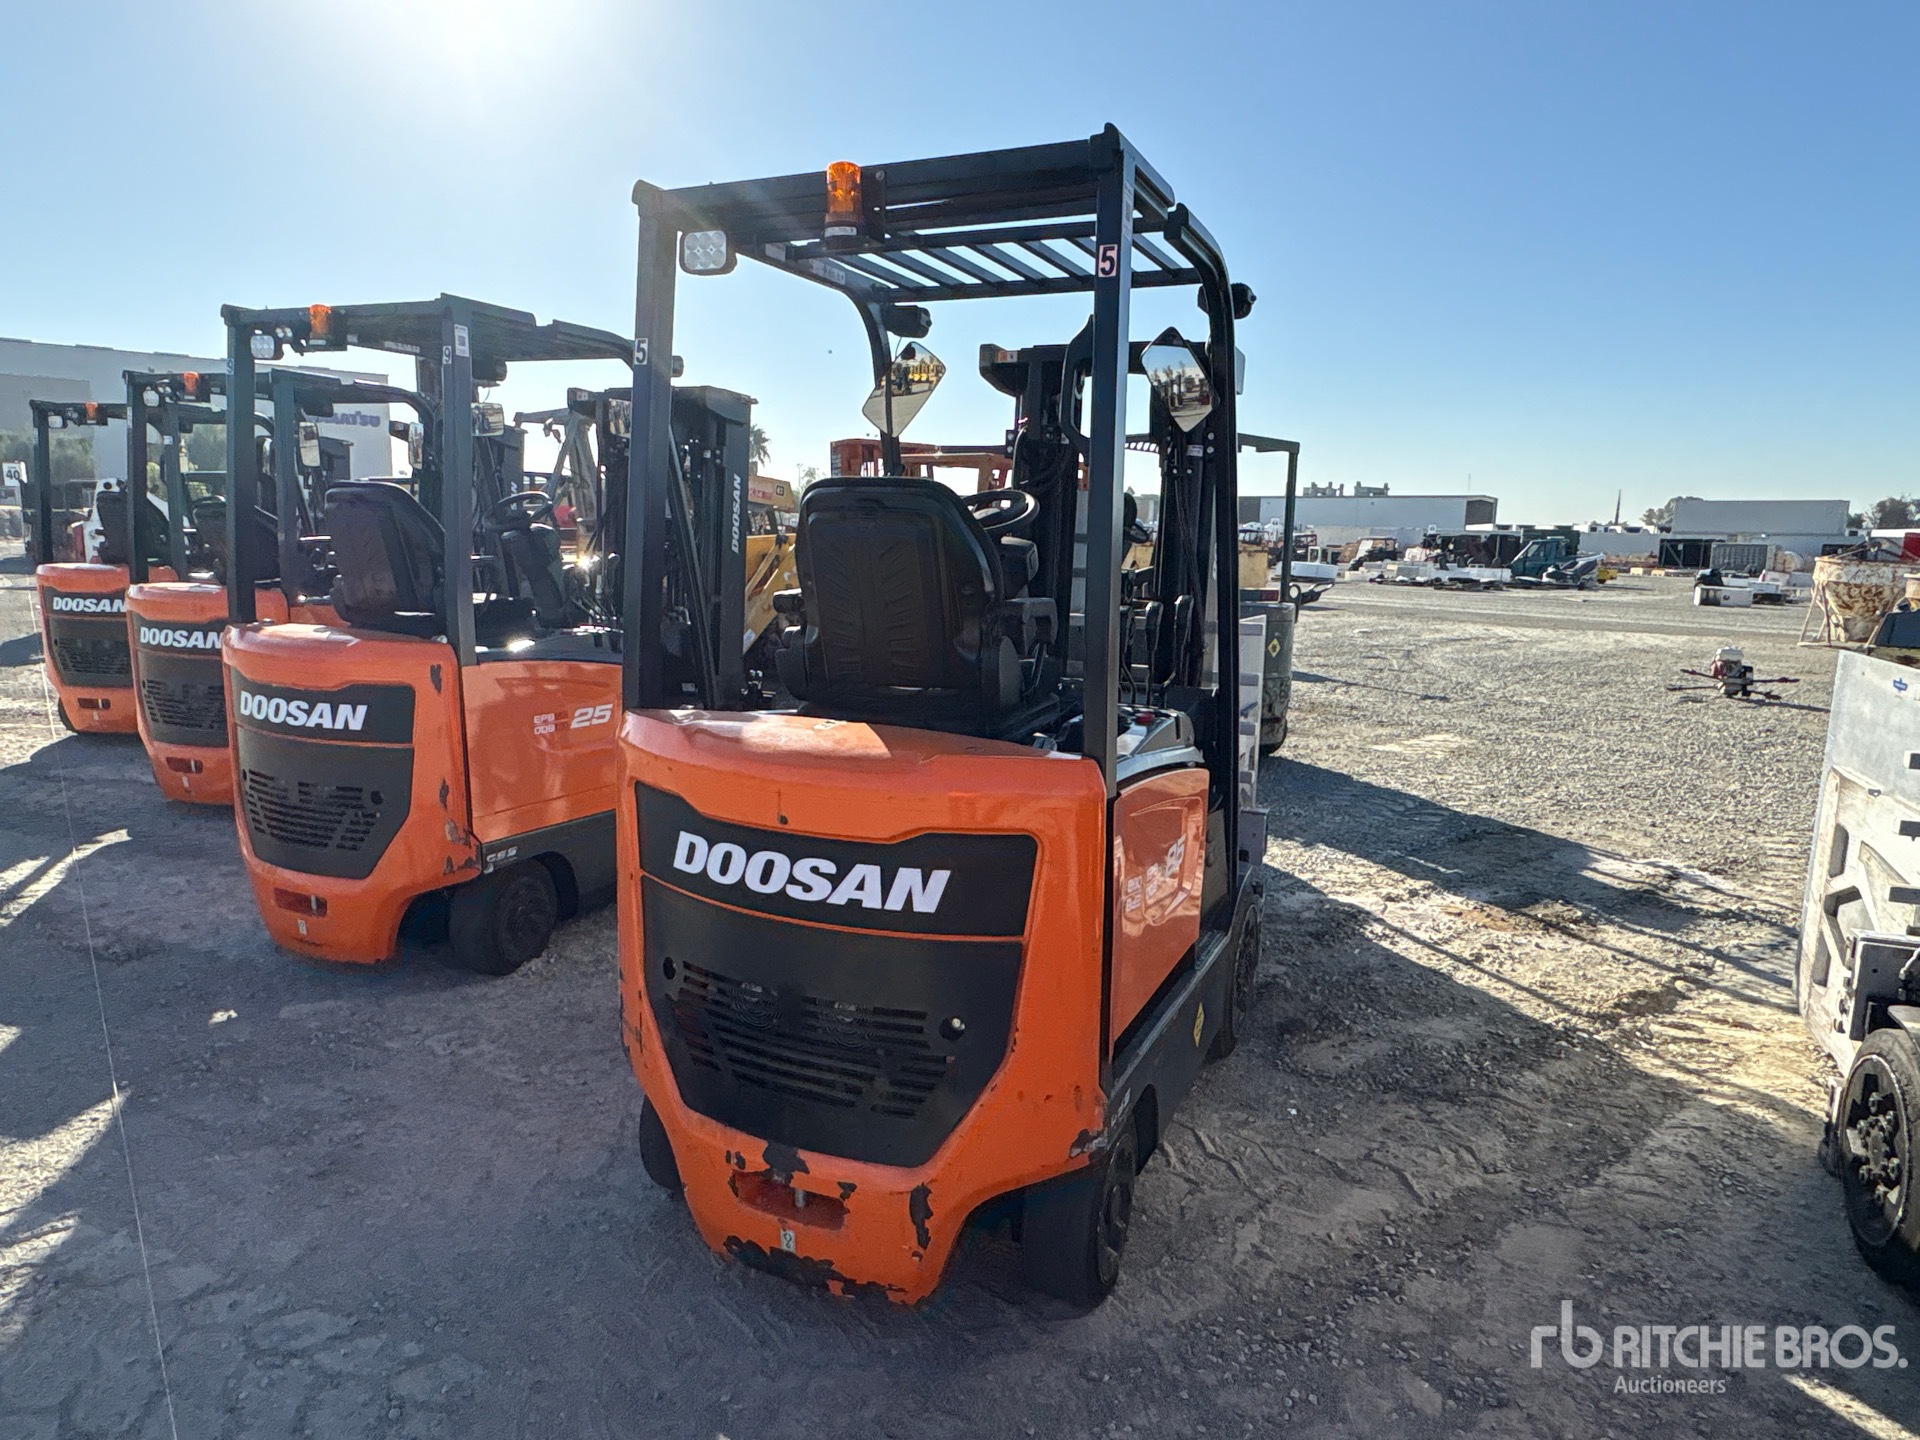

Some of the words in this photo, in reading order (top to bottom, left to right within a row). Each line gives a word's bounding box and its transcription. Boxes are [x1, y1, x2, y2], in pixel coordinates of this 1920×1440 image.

[1100, 246, 1116, 276] 5
[444, 347, 451, 363] 9
[636, 340, 646, 363] 5
[731, 473, 741, 553] DOOSAN
[53, 597, 127, 612] DOOSAN
[140, 627, 223, 649] DOOSAN
[240, 690, 368, 730] DOOSAN
[570, 704, 613, 729] 25
[673, 830, 951, 914] DOOSAN
